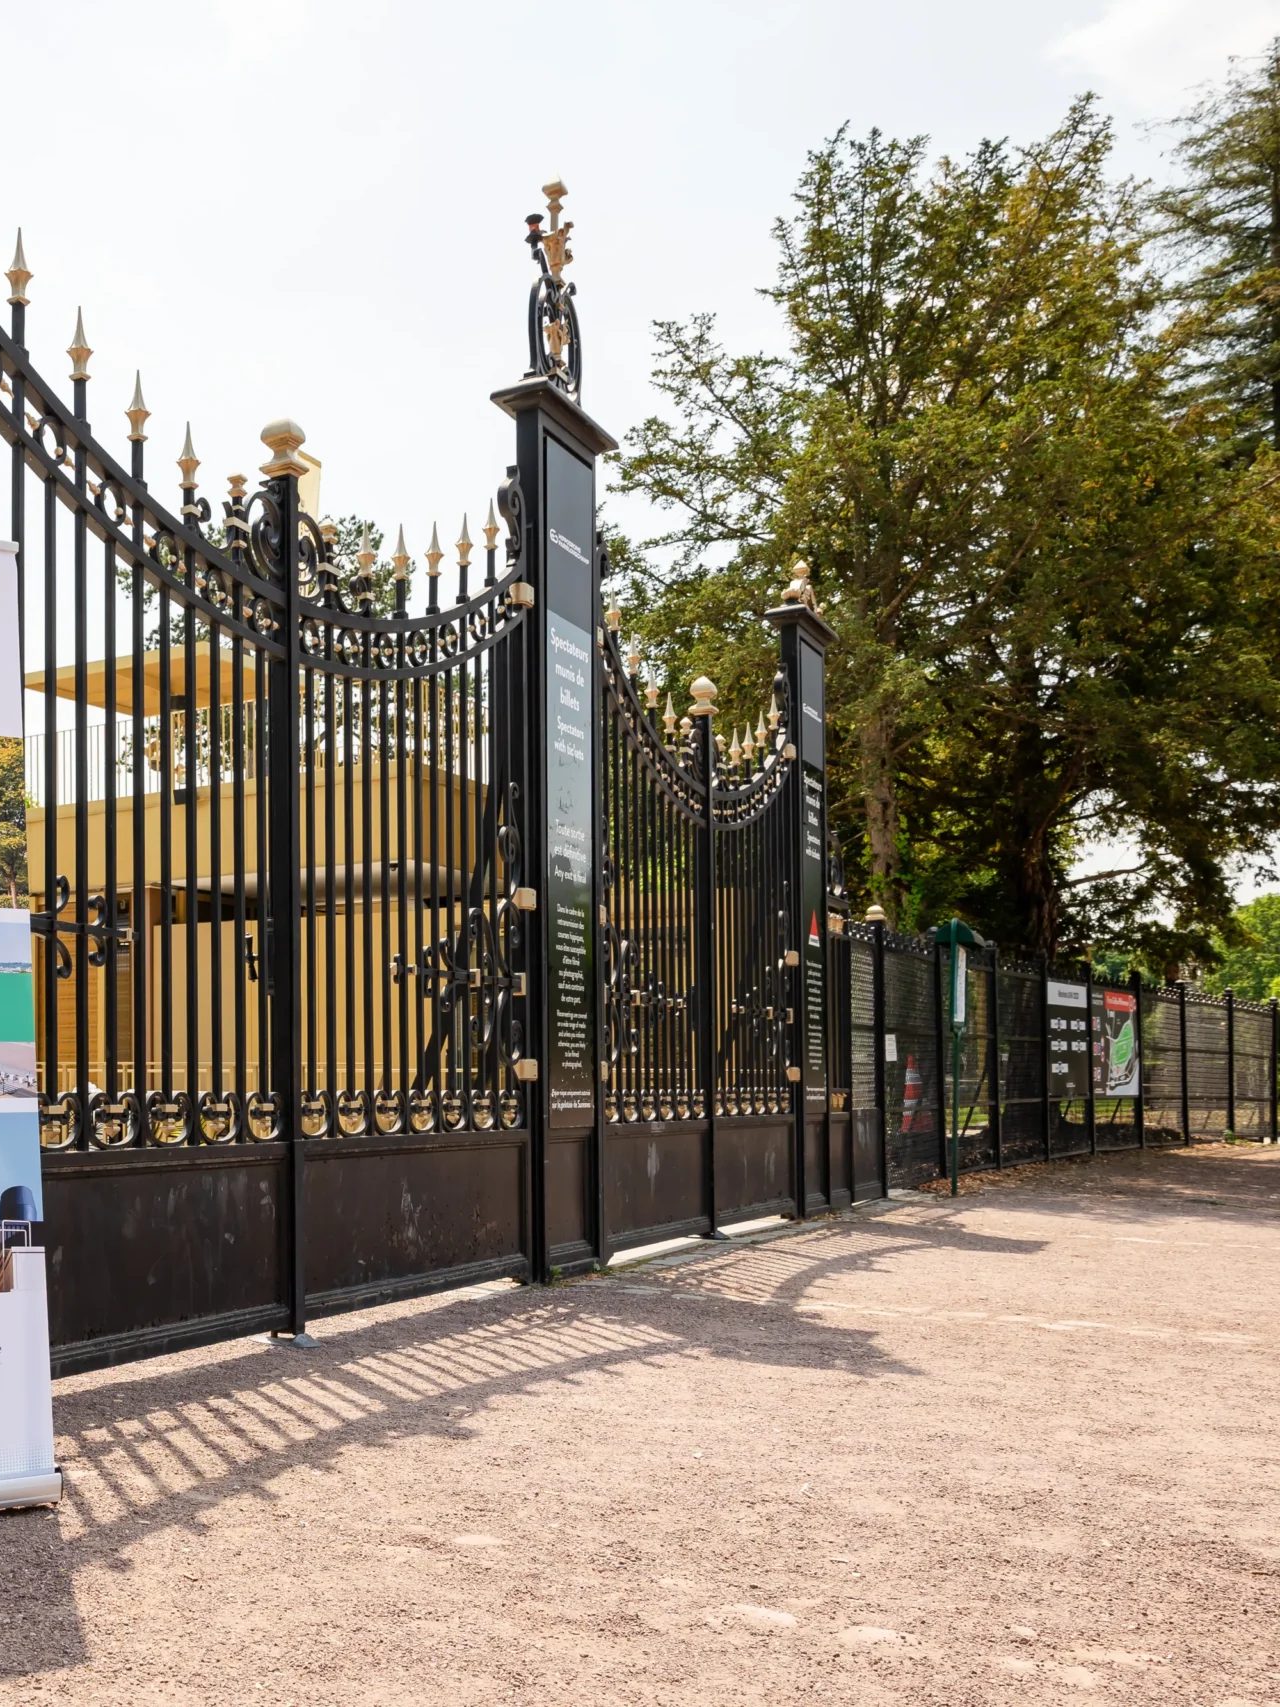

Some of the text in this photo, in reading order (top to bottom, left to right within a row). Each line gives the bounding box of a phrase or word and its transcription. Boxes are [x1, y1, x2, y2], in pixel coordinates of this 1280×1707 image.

[550, 627, 589, 663] Spectateurs
[555, 663, 584, 687] munis de
[560, 686, 580, 711] billets
[557, 715, 584, 740] Spectators
[554, 738, 566, 754] with
